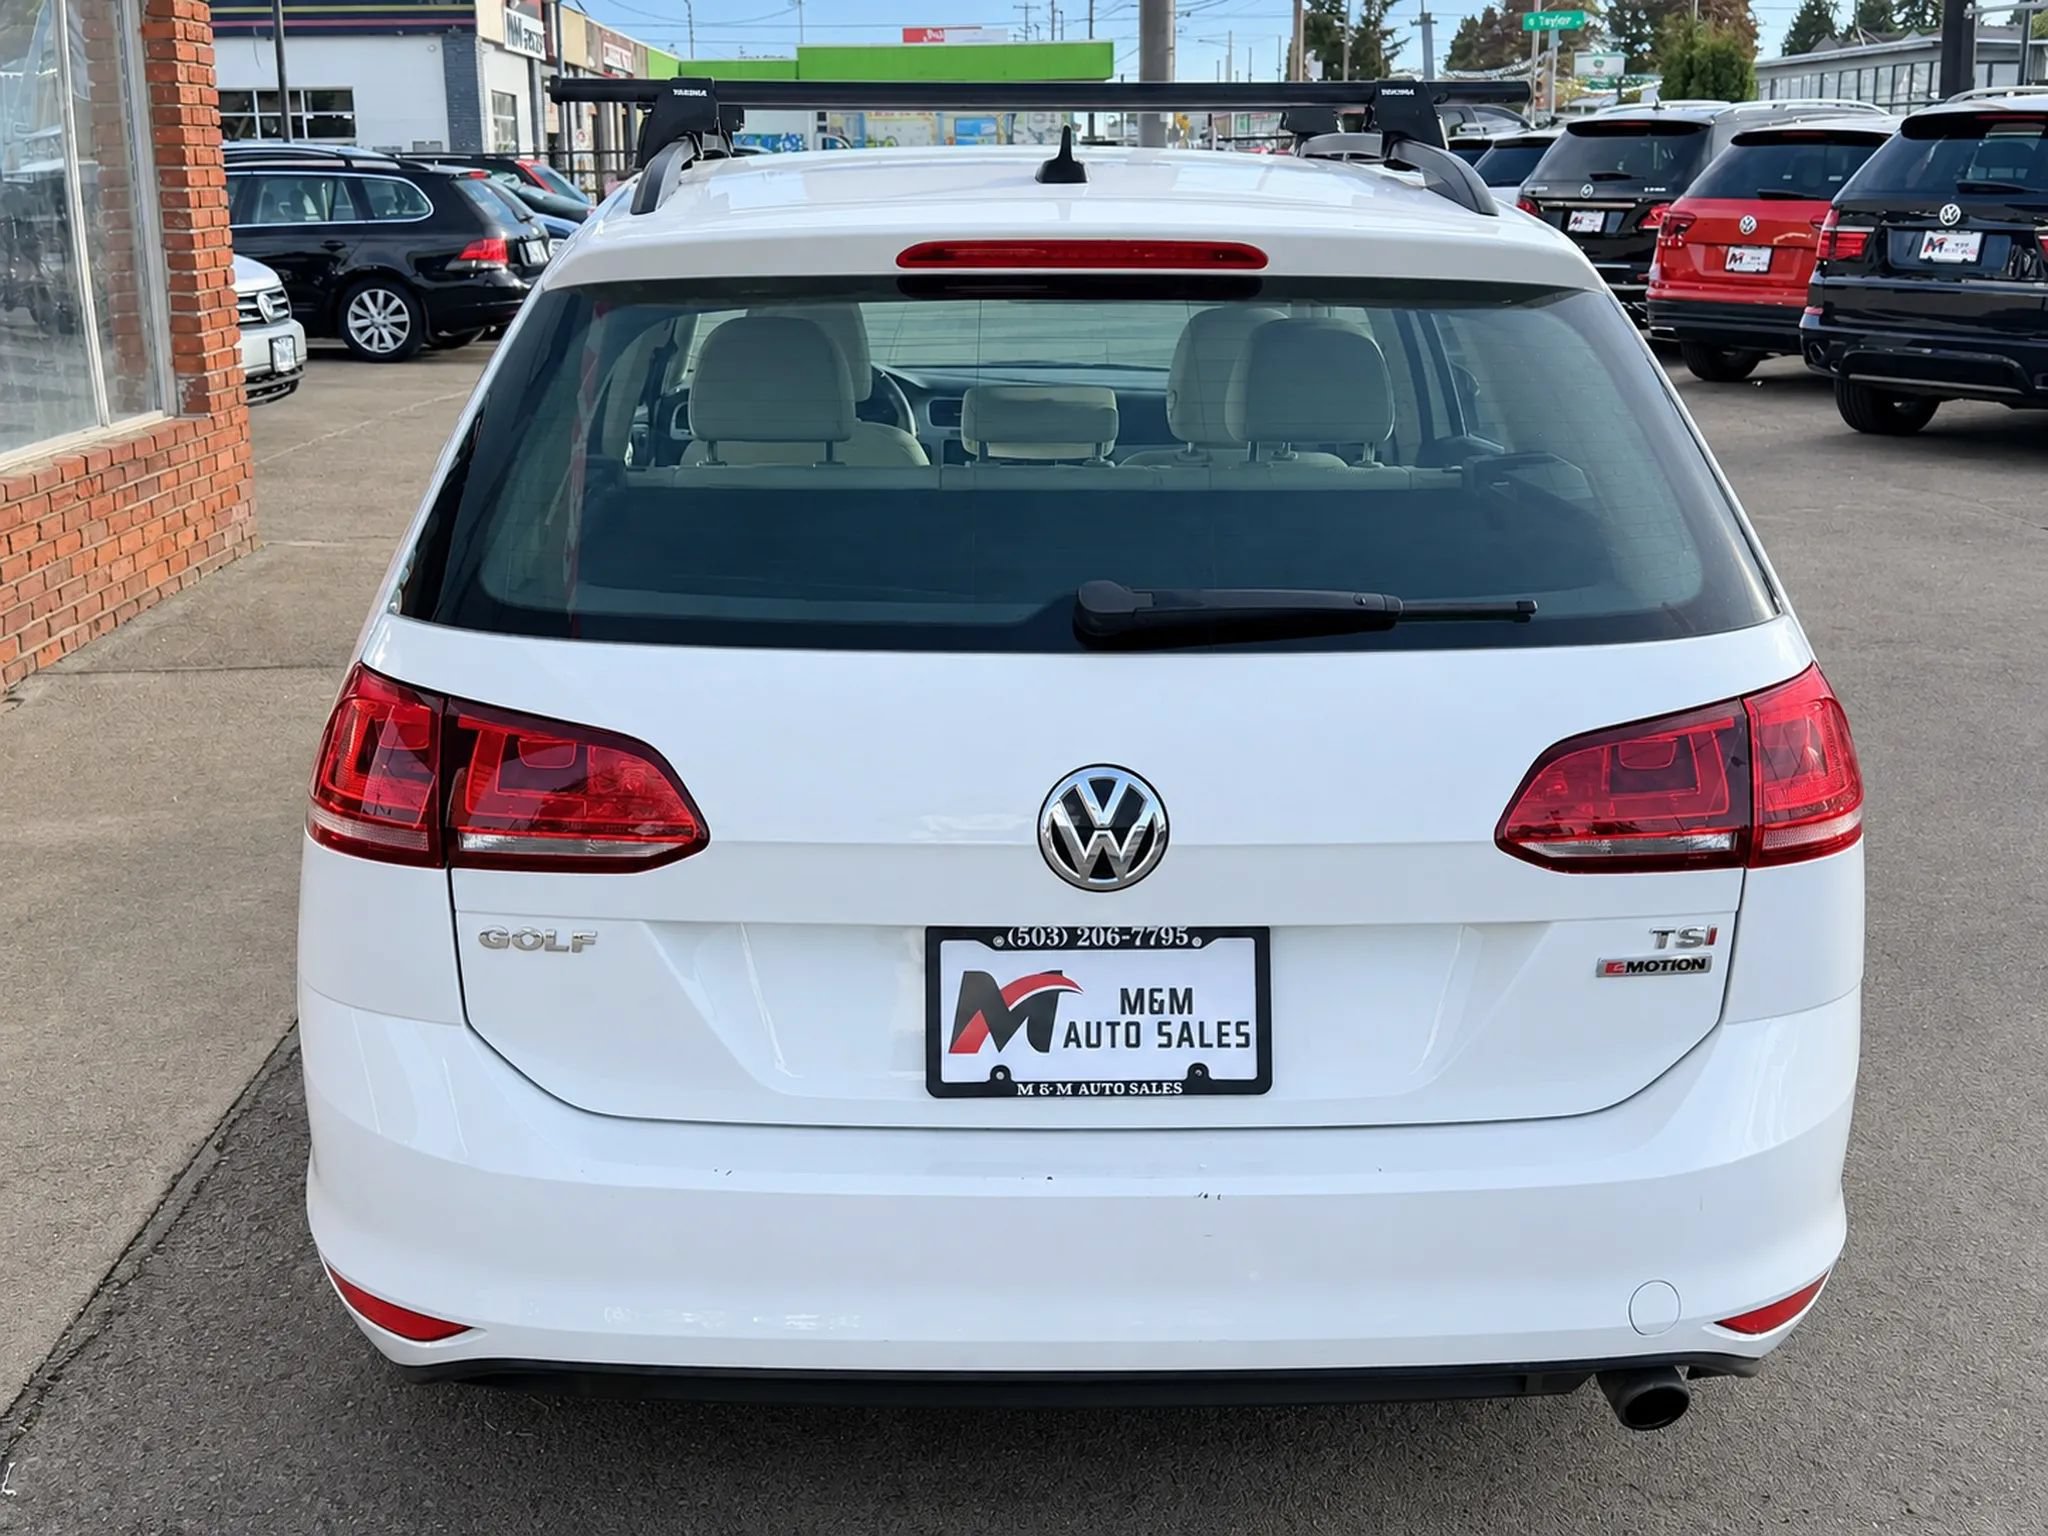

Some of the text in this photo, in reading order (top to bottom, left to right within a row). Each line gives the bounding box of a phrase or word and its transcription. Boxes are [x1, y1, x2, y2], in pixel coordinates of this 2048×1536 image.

[478, 925, 598, 953] GOLF
[1007, 926, 1190, 948] (503) 206-7795
[1649, 924, 1719, 949] TSI
[1120, 987, 1193, 1015] M&M
[1063, 1021, 1251, 1049] AUTO SALES
[1078, 1082, 1125, 1096] AUTO
[1129, 1082, 1183, 1096] SALES
